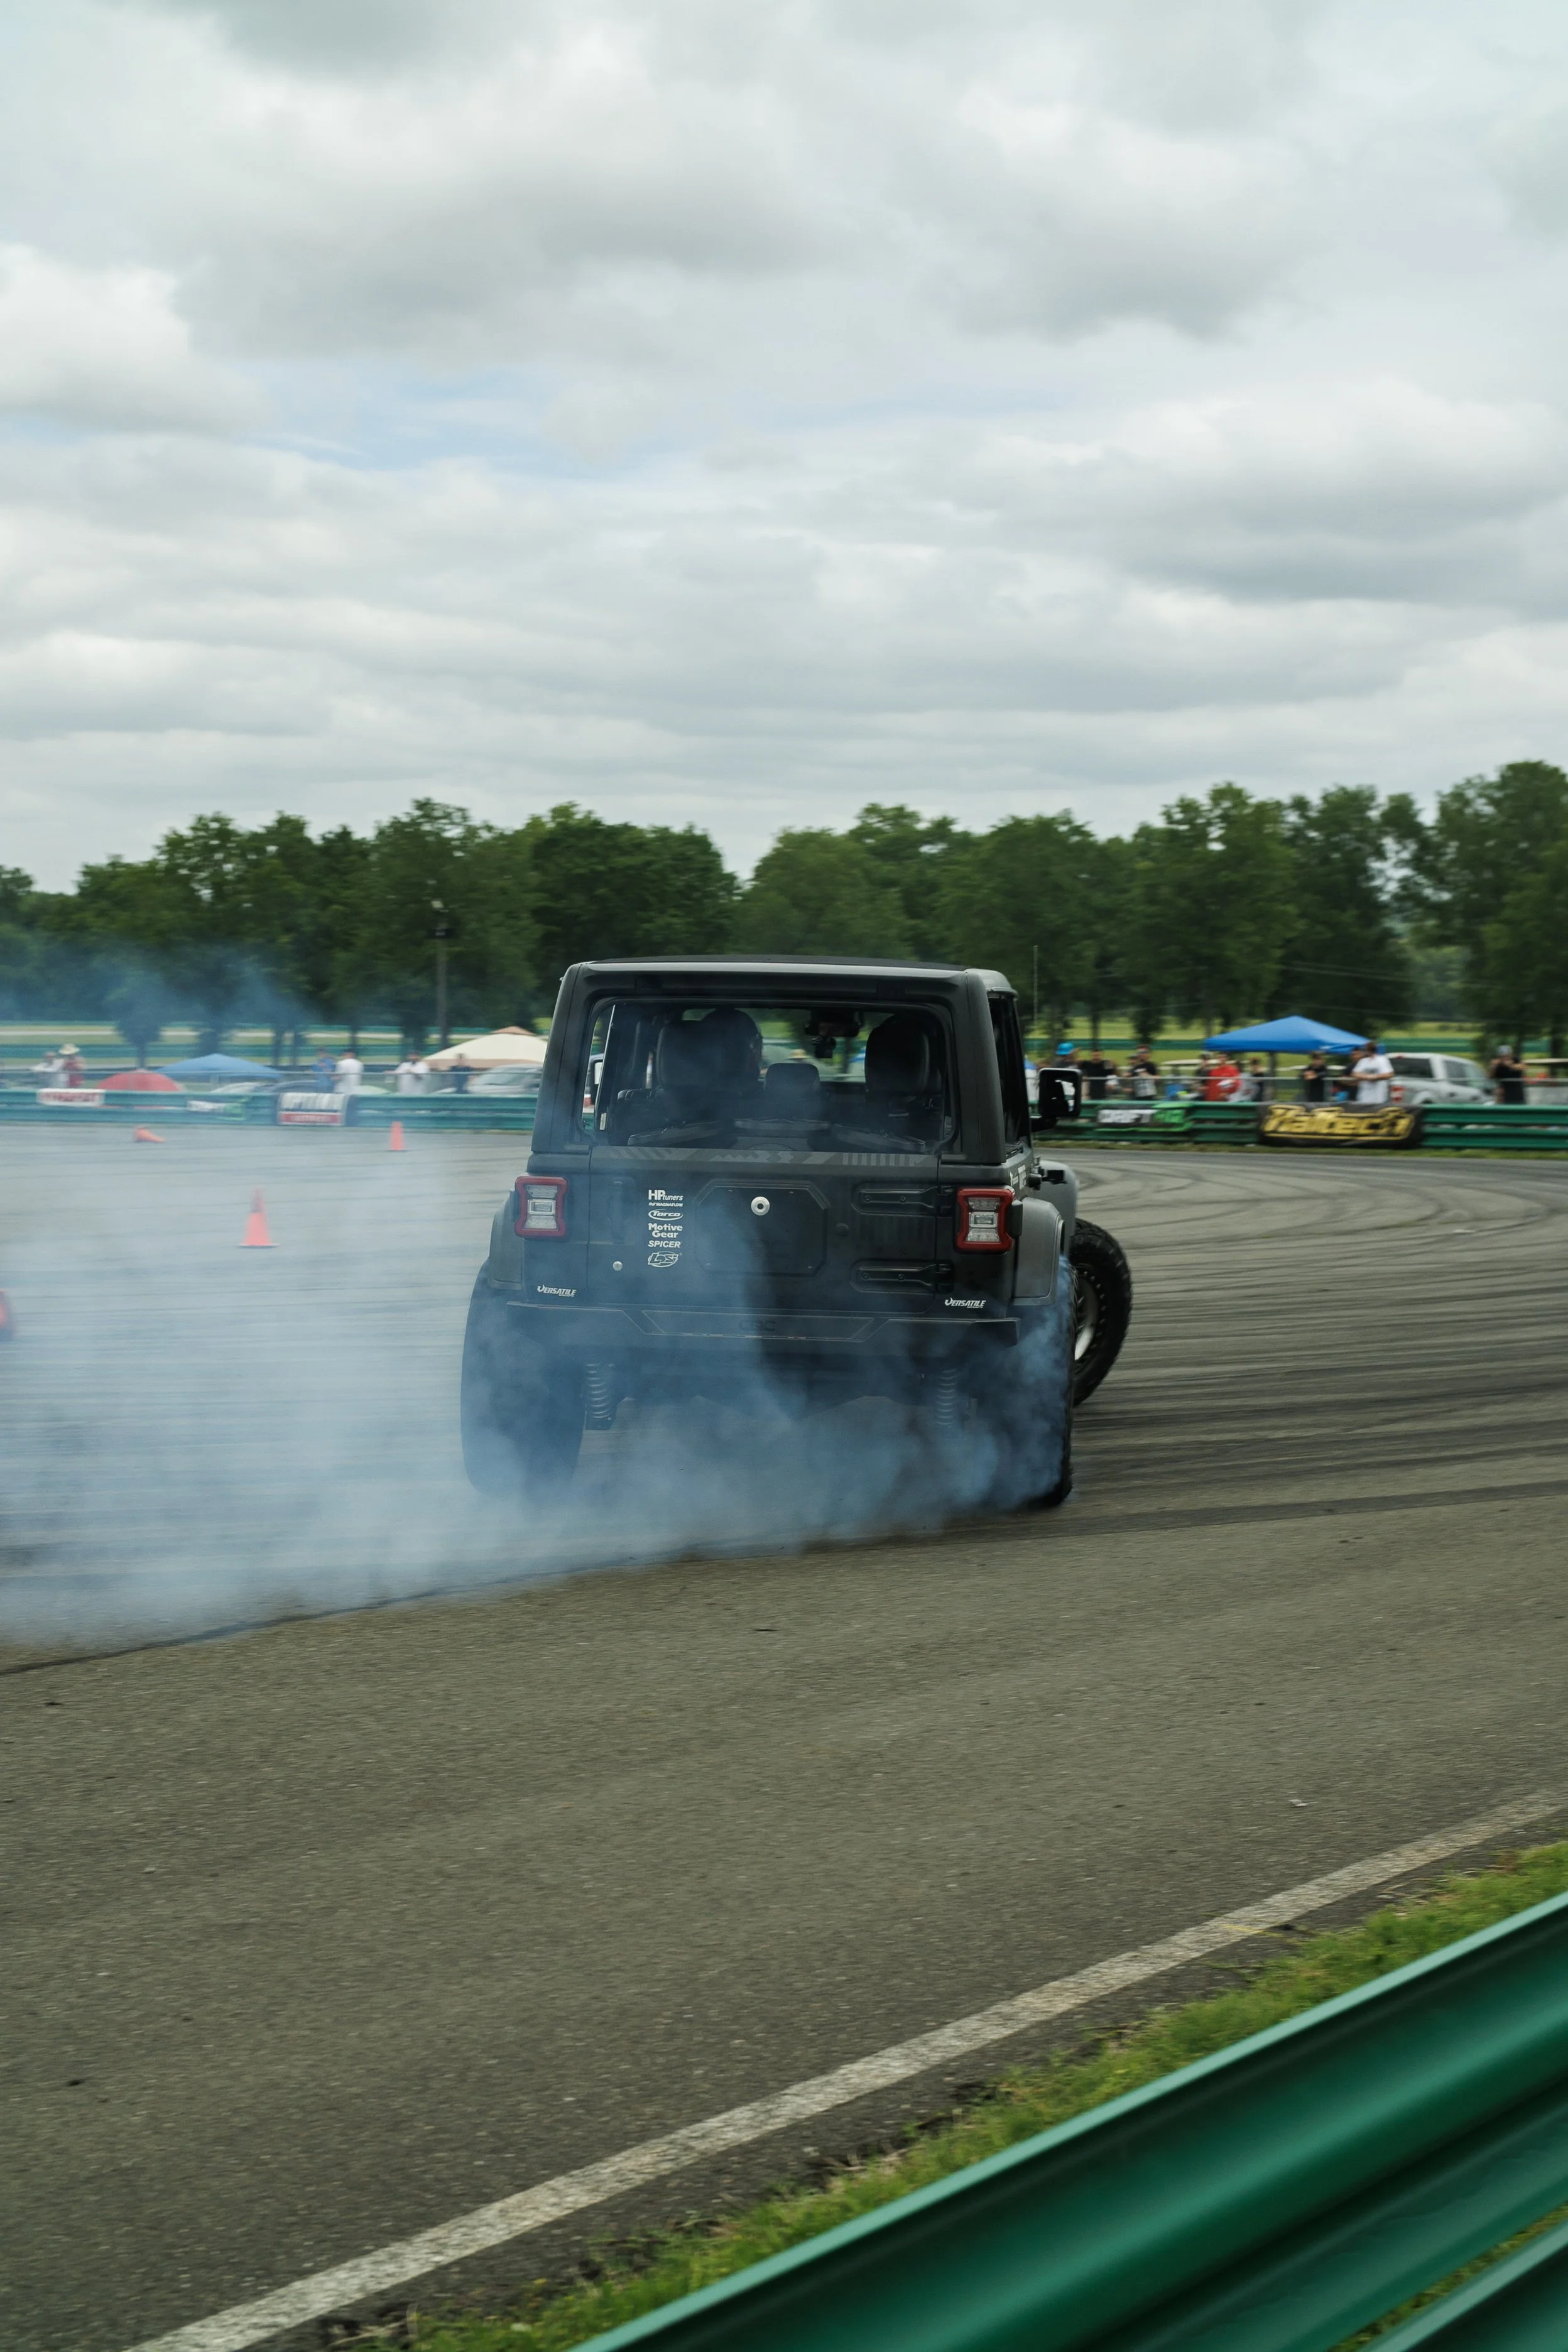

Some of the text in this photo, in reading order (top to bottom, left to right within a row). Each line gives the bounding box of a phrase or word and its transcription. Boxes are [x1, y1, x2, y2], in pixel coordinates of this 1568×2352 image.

[648, 1222, 683, 1231] Motive
[652, 1230, 678, 1238] Gear
[648, 1240, 681, 1248] SPICER
